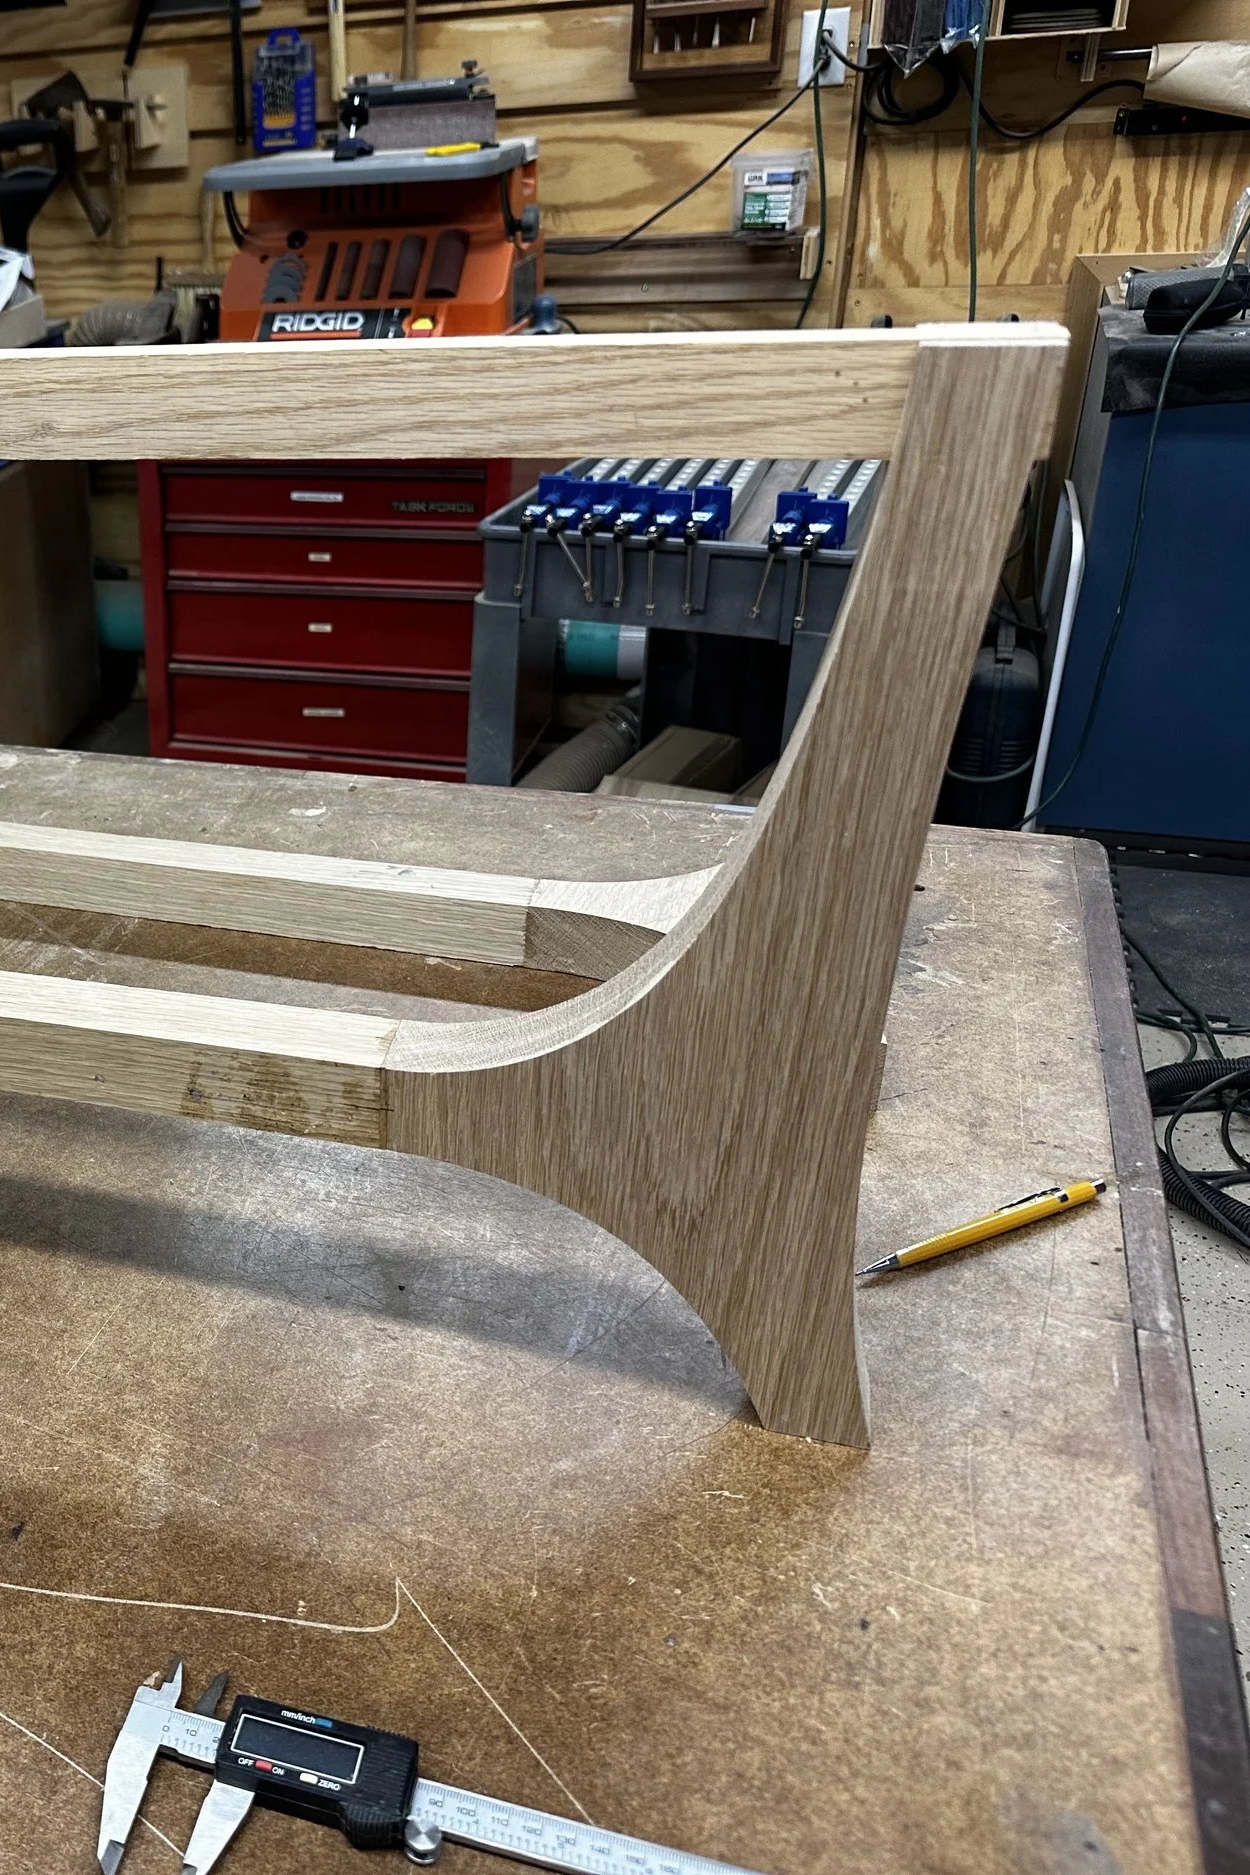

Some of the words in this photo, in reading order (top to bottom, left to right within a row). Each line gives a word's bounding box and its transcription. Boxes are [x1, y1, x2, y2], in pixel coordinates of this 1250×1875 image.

[271, 313, 364, 332] RIDGID
[391, 501, 428, 512] TASK
[281, 1709, 316, 1724] mm/inch
[186, 1728, 197, 1737] 10
[238, 1757, 254, 1767] OFF
[272, 1767, 284, 1776] ON
[318, 1779, 341, 1791] ZERO
[456, 1806, 476, 1817] 100
[491, 1815, 509, 1826] 110
[523, 1824, 542, 1836] 120
